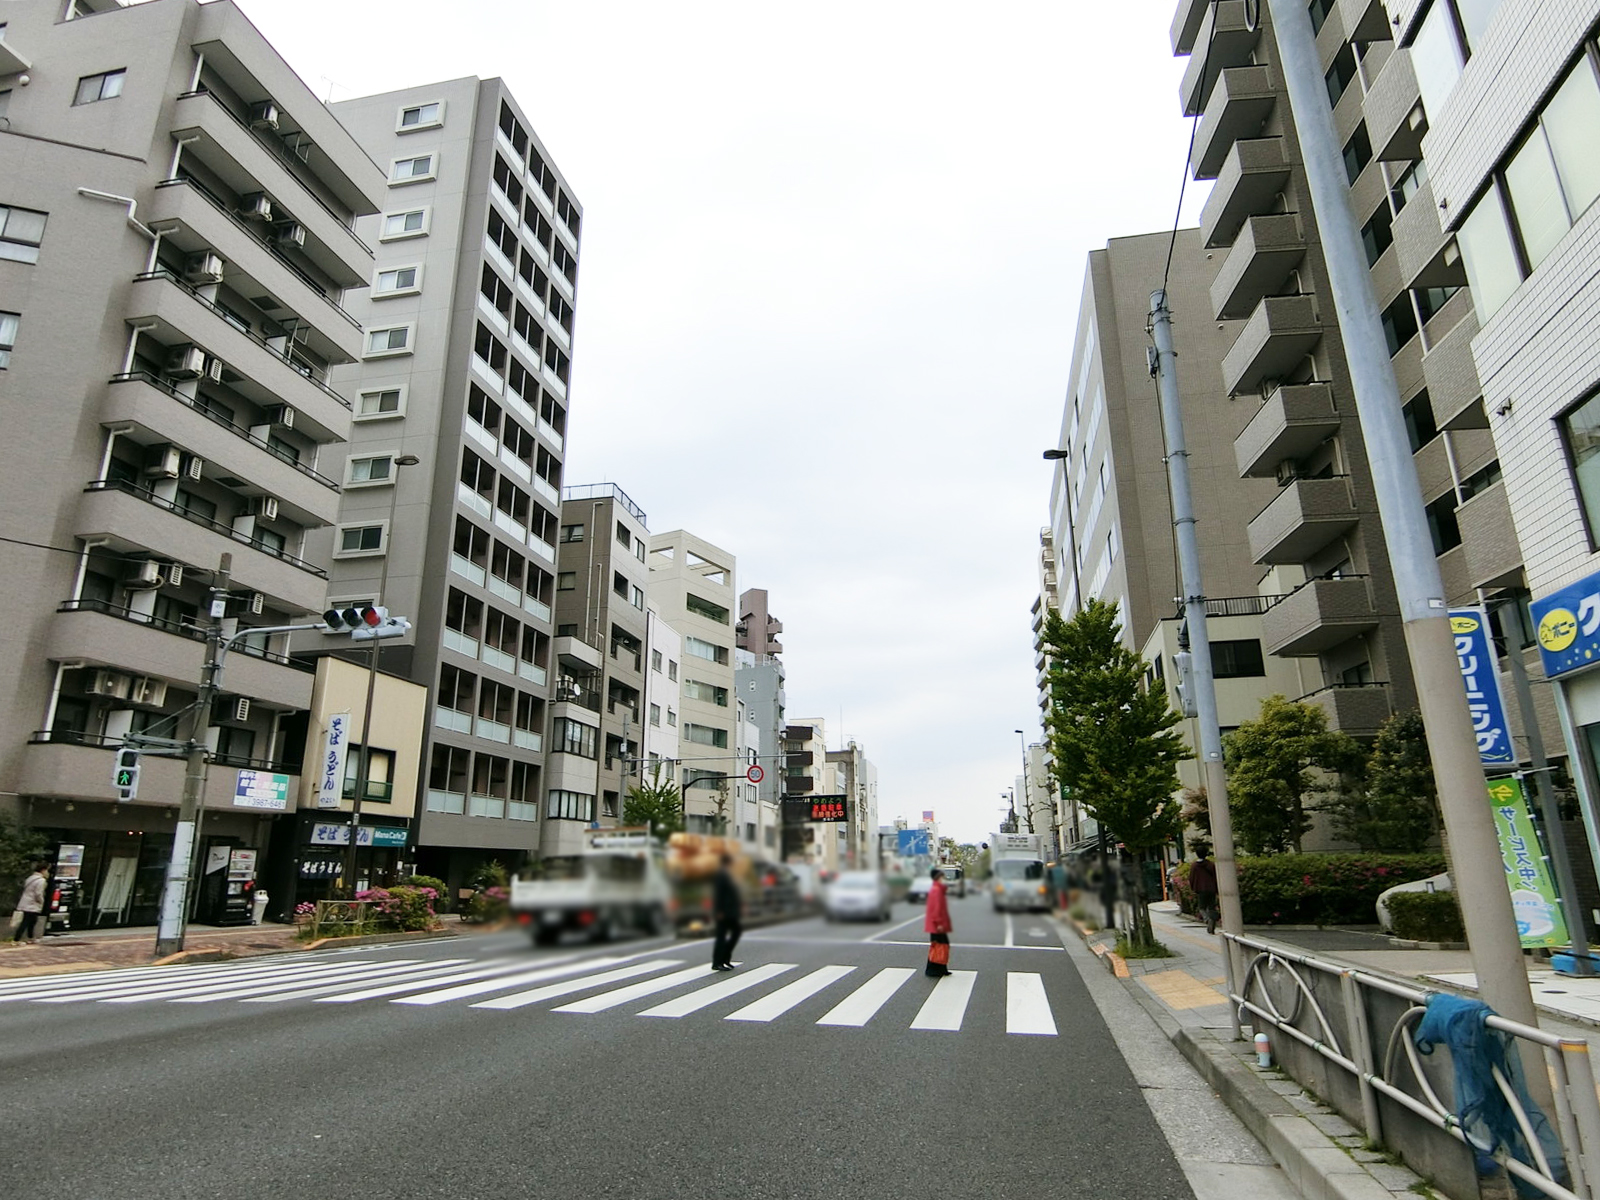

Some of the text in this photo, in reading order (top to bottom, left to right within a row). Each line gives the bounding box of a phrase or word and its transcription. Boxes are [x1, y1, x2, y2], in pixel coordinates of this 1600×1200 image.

[1454, 636, 1502, 753] クリーニング
[323, 717, 343, 791] そば うどん
[751, 769, 761, 778] 50
[317, 825, 340, 840] そば
